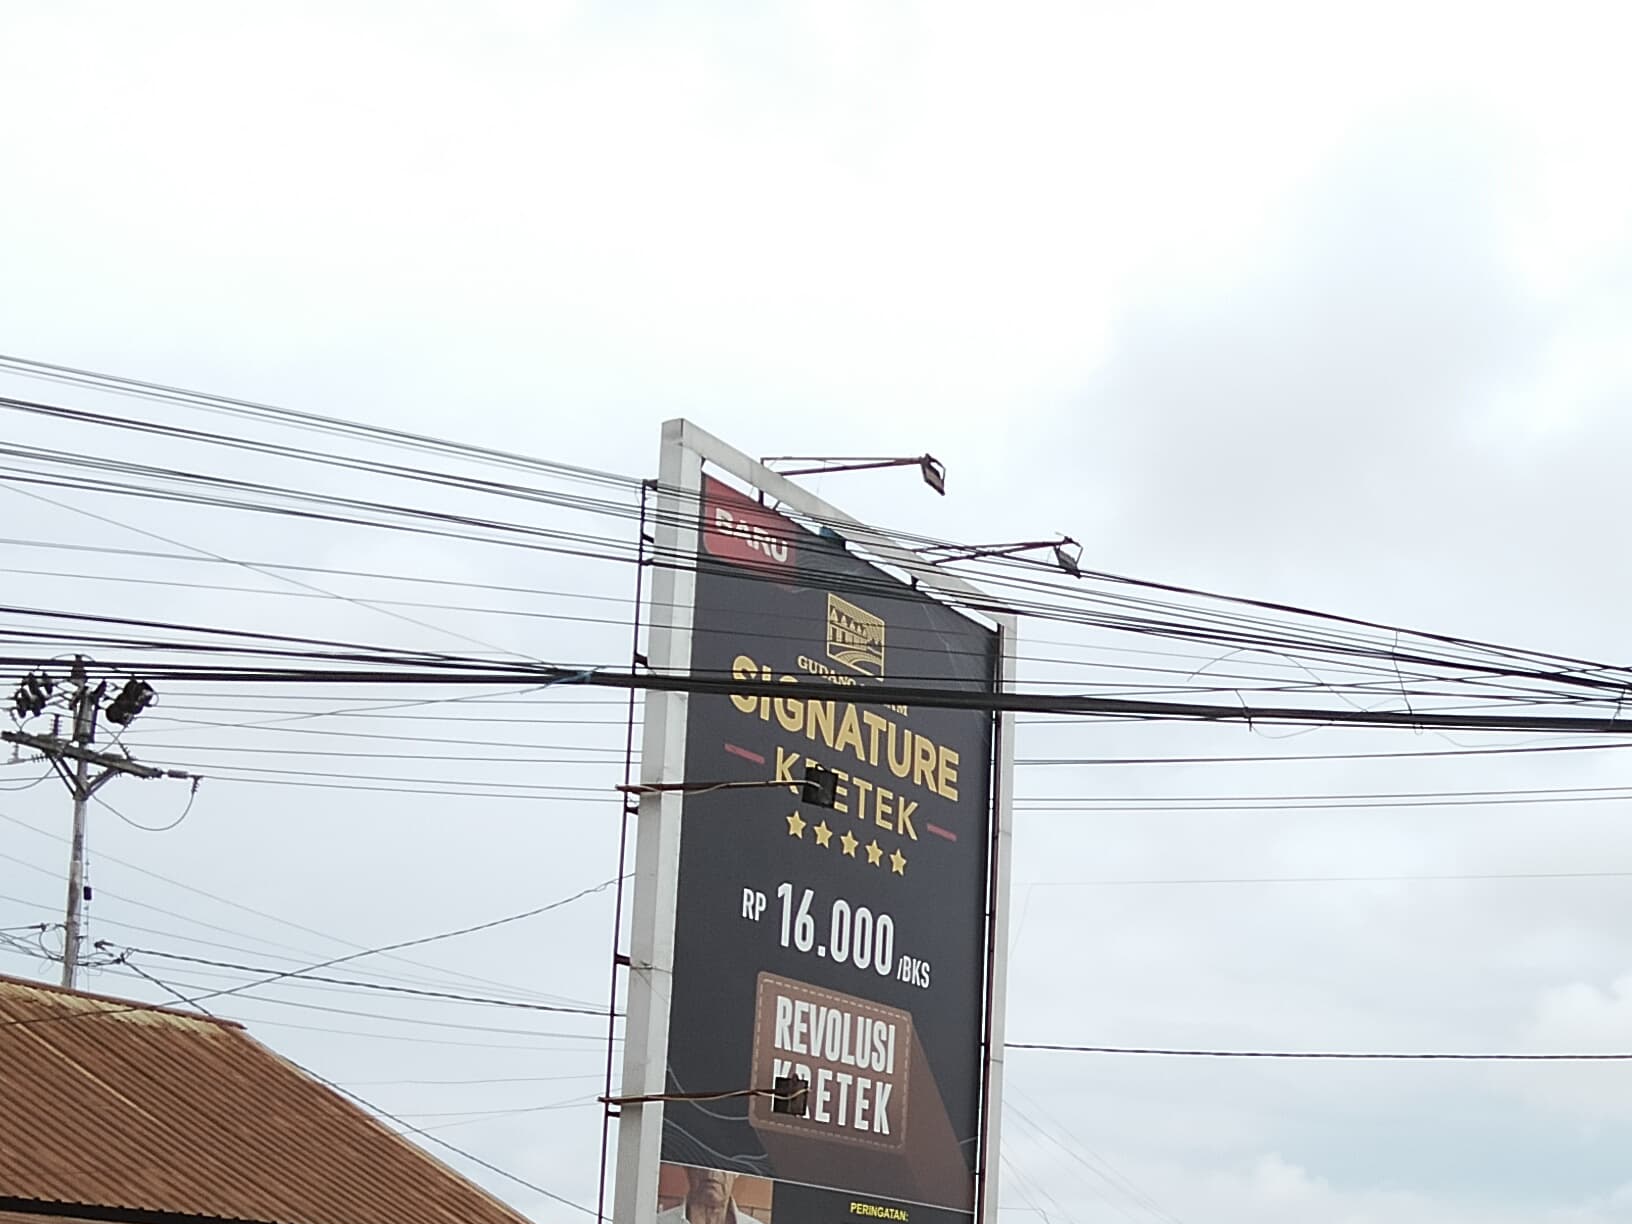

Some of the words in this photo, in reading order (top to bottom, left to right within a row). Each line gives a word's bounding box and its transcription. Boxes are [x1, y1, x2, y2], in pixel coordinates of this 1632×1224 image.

[715, 508, 787, 562] BARU
[729, 655, 960, 801] SIGNATURE
[775, 746, 918, 841] KETEK
[742, 887, 767, 922] RP
[777, 882, 895, 976] 16.000
[896, 955, 931, 989] /BKS
[774, 995, 896, 1075] REVOLUSI
[850, 1202, 909, 1222] PERINGATAN:
